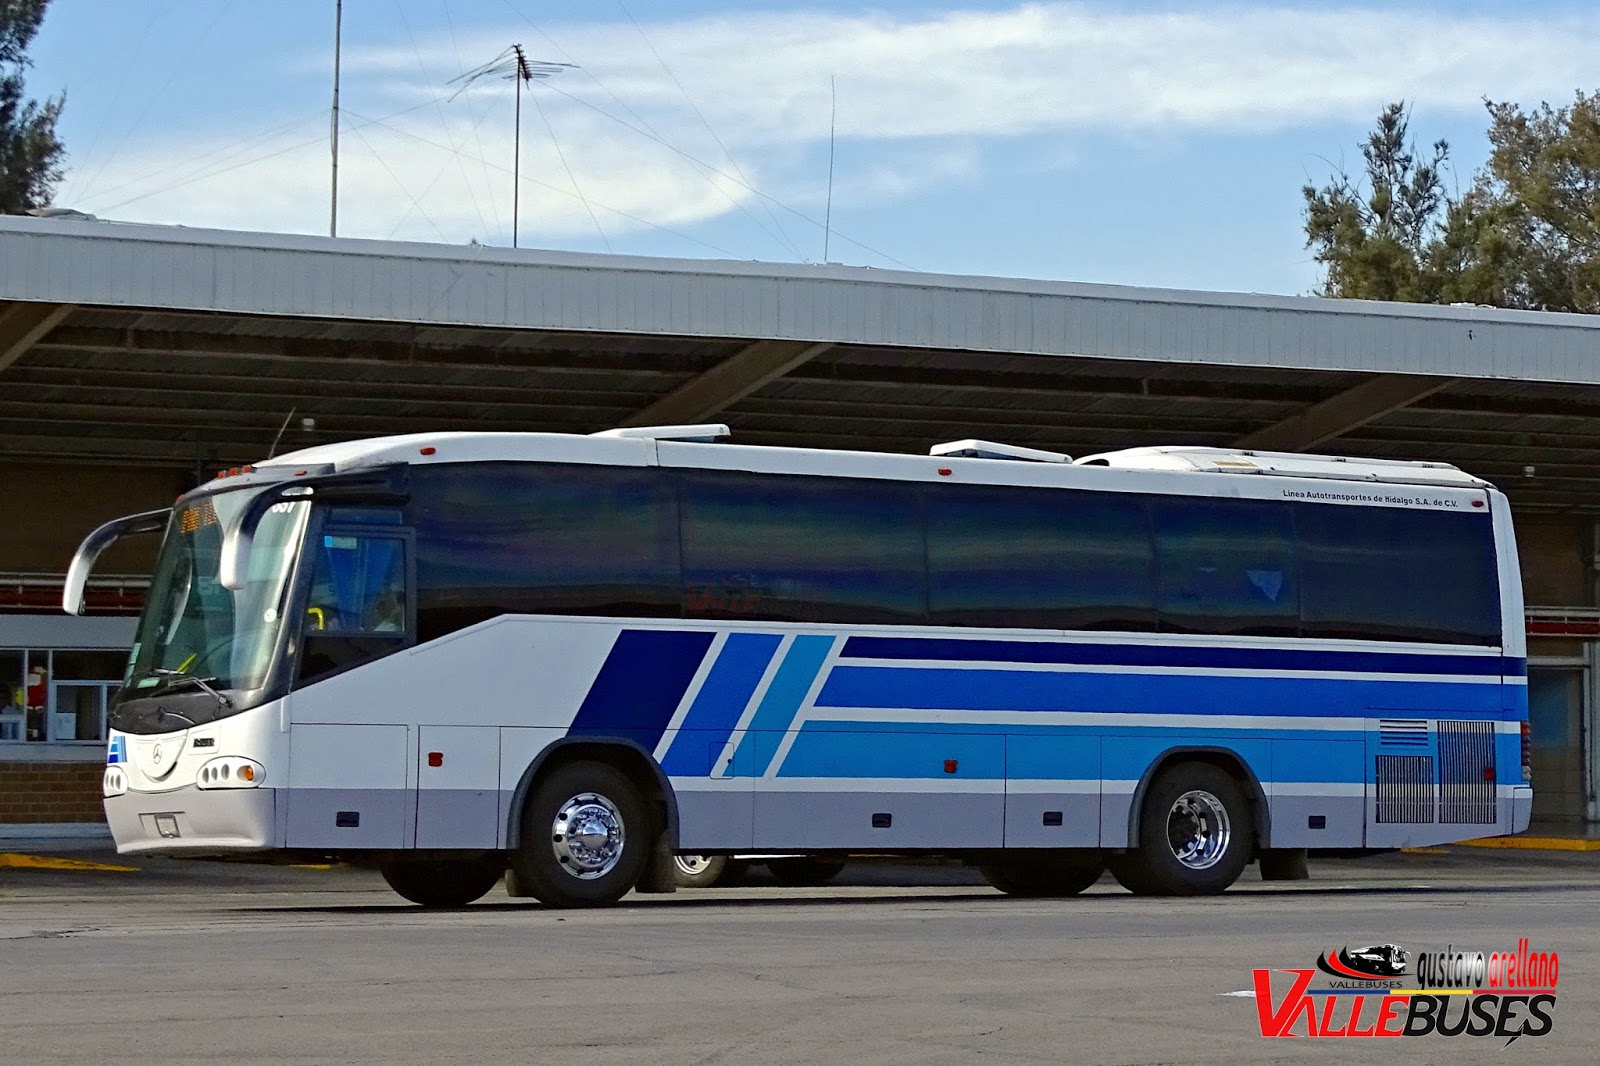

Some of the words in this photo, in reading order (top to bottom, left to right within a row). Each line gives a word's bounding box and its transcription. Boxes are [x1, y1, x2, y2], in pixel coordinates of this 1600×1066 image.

[1307, 491, 1371, 503] Autotransportes
[1373, 494, 1383, 502] de
[1385, 496, 1413, 505] Hidalgo
[1415, 498, 1432, 506] S.A.
[1433, 499, 1443, 507] de
[1444, 500, 1460, 508] C.V.
